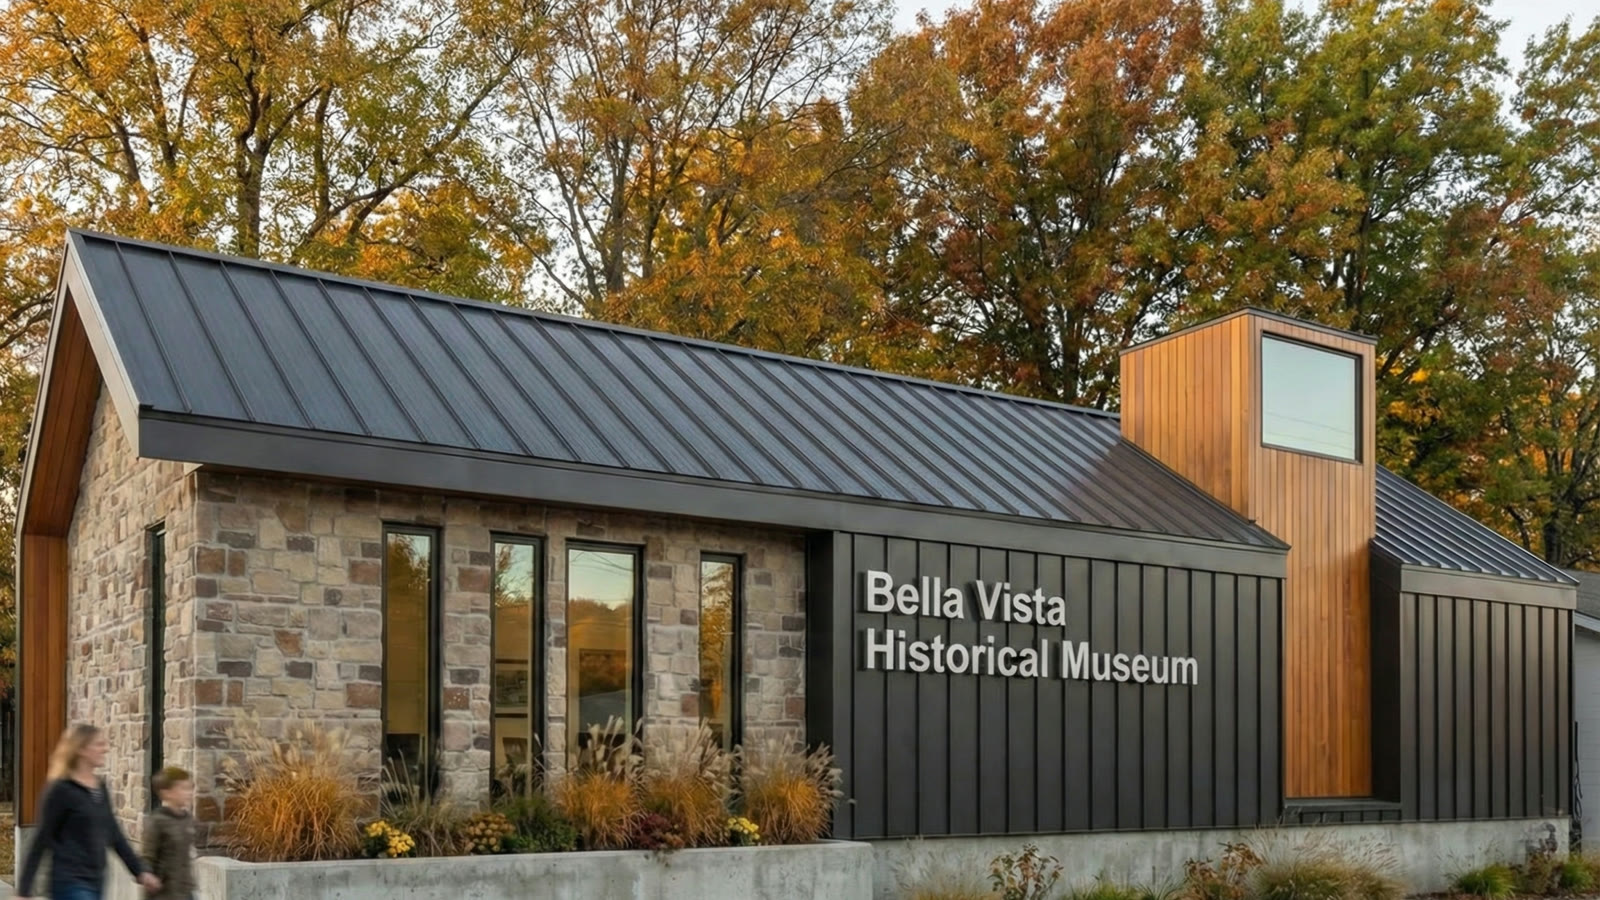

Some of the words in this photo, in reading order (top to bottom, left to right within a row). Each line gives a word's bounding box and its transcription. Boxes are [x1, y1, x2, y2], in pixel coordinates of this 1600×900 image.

[867, 569, 965, 619] Bella
[975, 579, 1067, 626] Vista
[866, 627, 1049, 678] Historical
[1062, 640, 1198, 685] Museum
